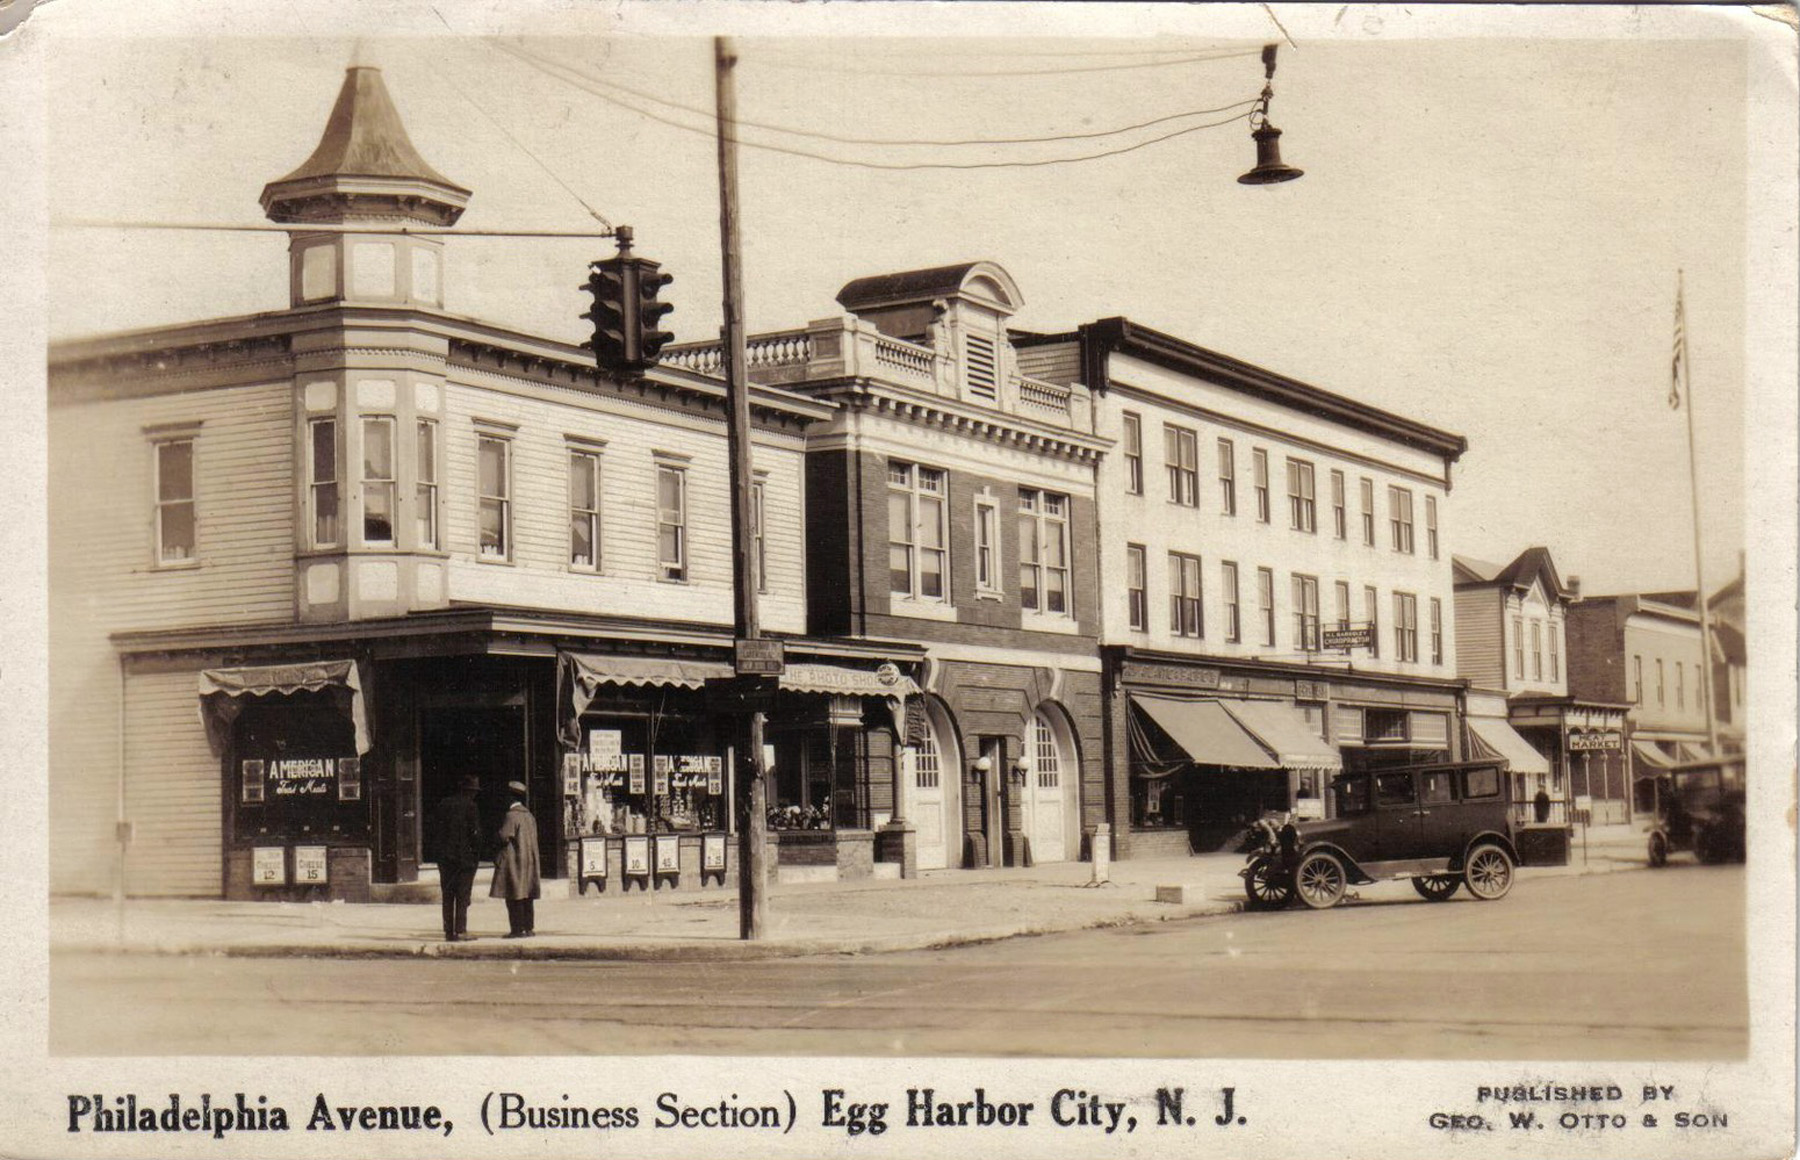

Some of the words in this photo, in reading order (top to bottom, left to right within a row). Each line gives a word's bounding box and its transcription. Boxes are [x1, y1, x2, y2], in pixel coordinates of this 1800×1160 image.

[809, 671, 847, 685] PHOTO
[1571, 740, 1618, 749] MARKET
[269, 759, 334, 779] AMERICAN
[263, 870, 276, 880] 12
[307, 869, 319, 880] 15
